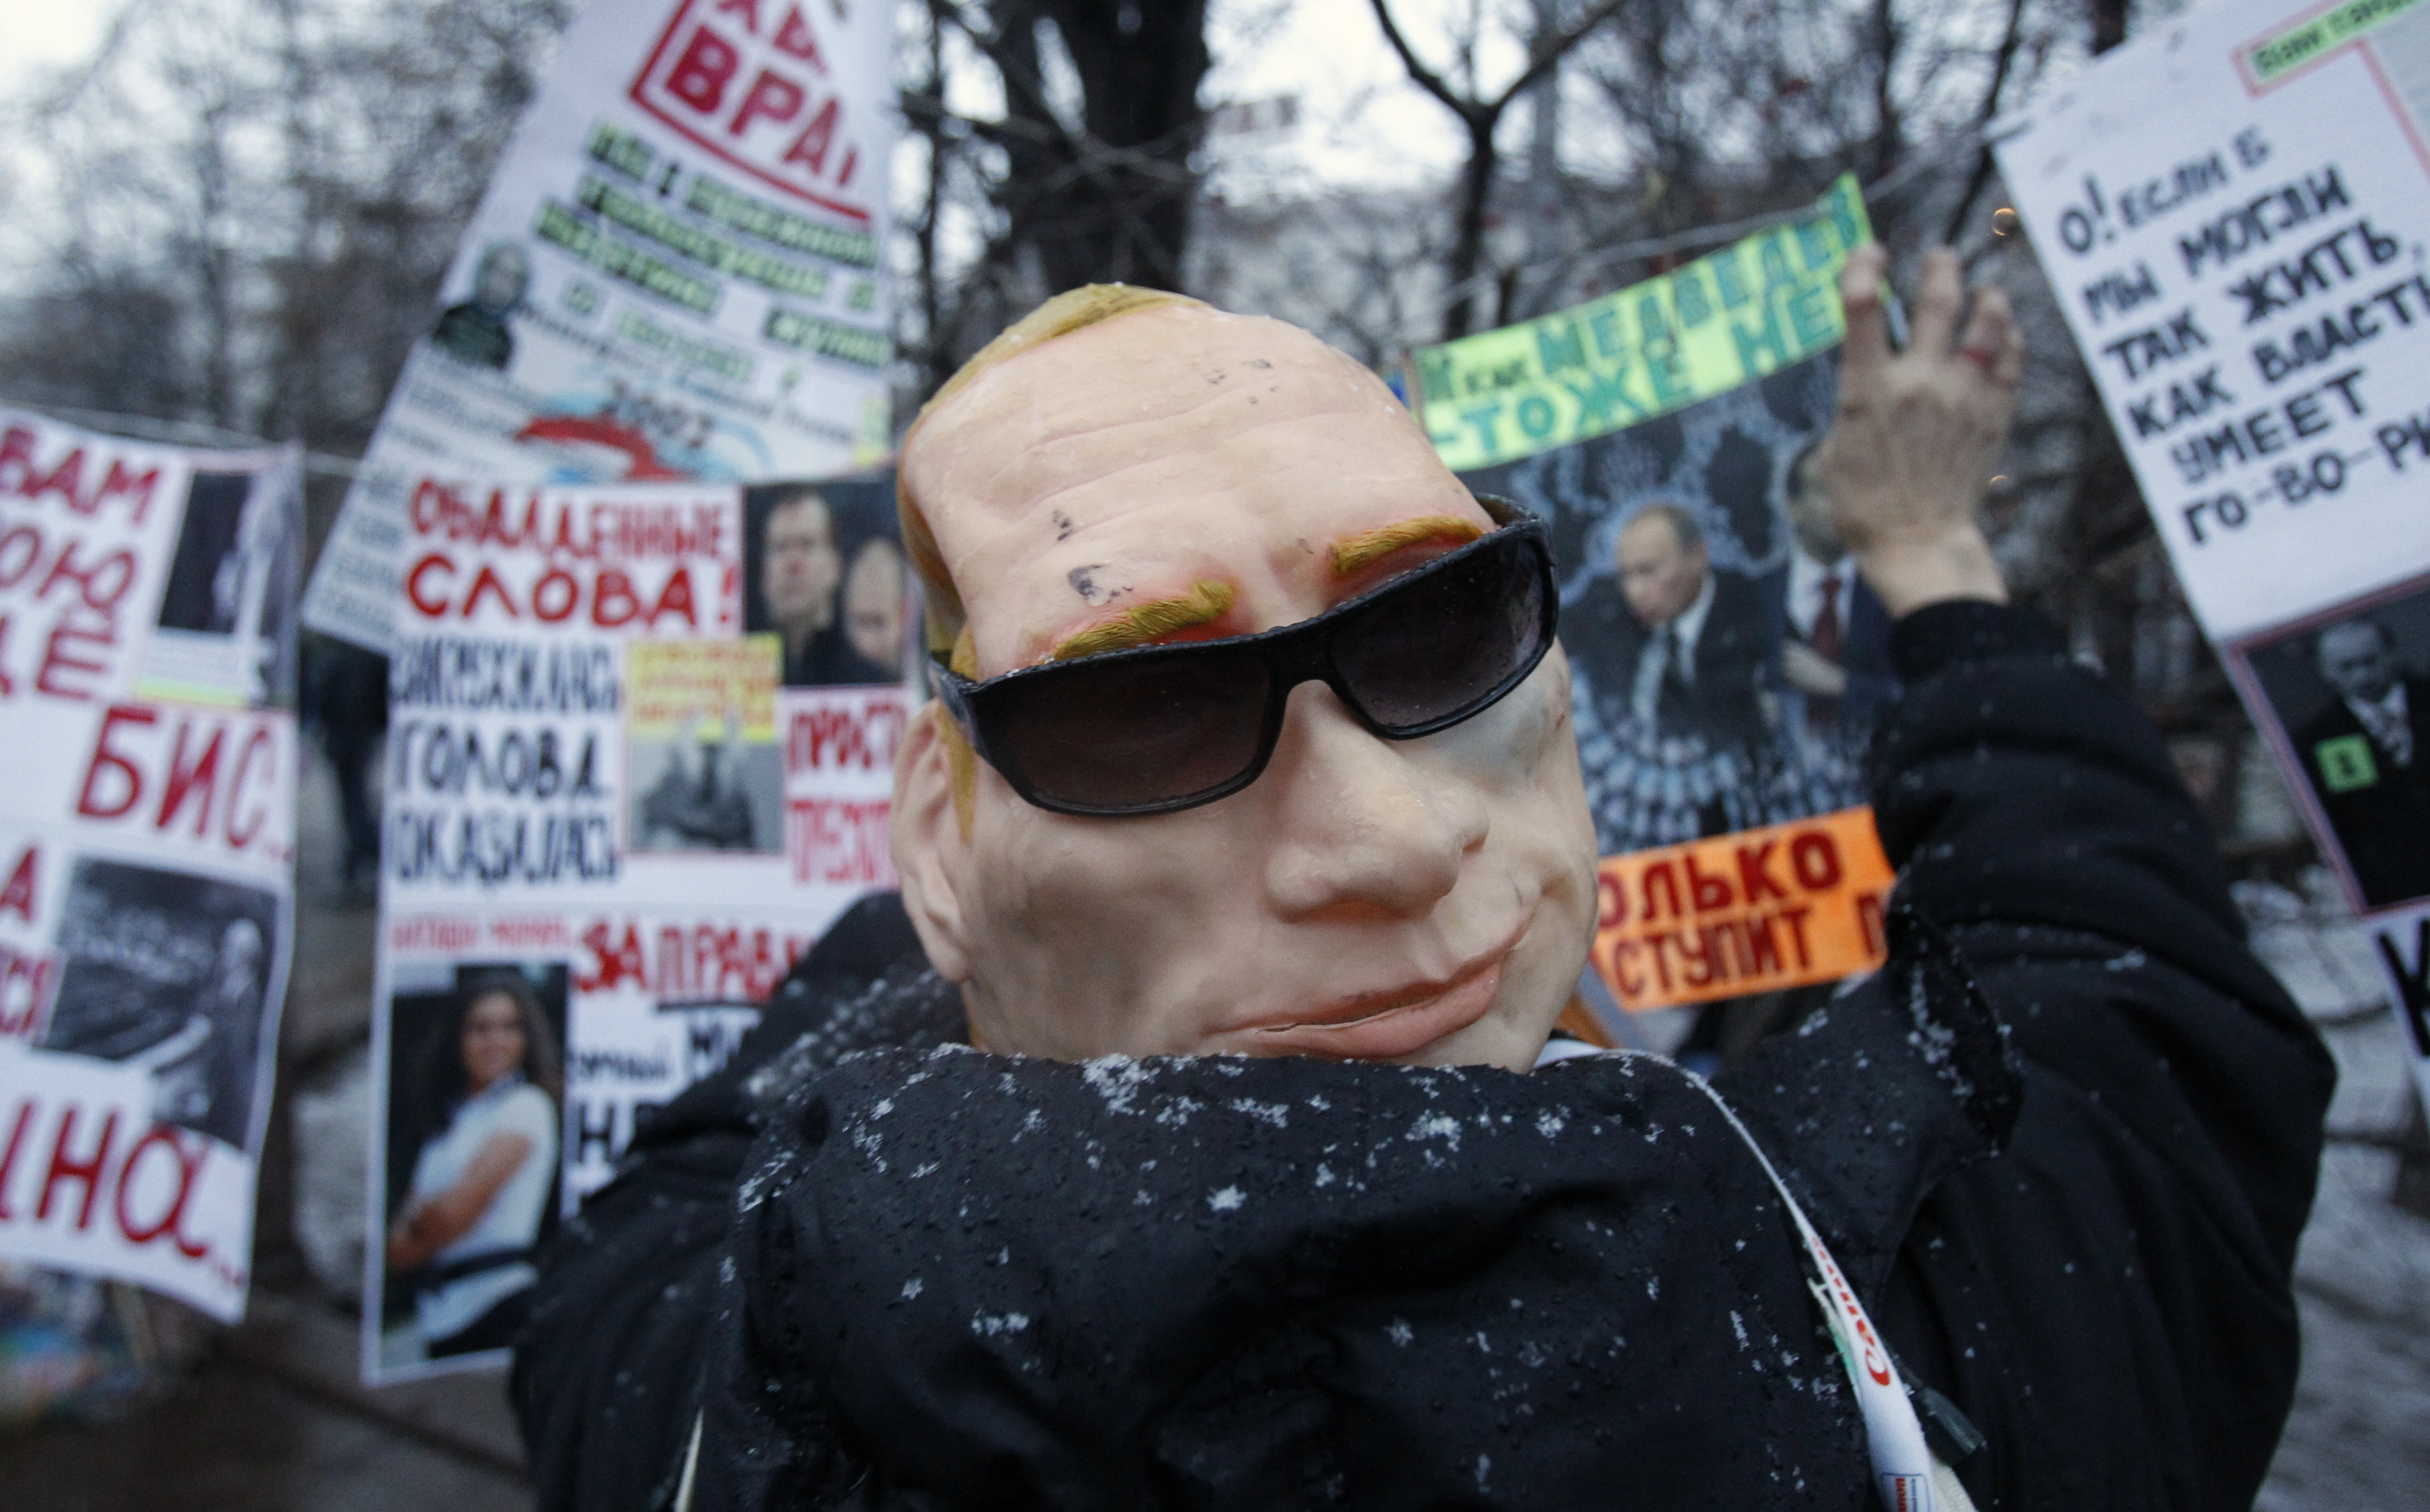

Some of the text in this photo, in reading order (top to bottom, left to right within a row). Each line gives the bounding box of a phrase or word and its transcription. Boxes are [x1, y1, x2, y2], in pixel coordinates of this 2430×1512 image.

[2104, 308, 2209, 379] ТАК
[2127, 368, 2231, 439] КАК
[2172, 368, 2365, 485] УМЕЕТ
[405, 553, 735, 629] СЛОВА!
